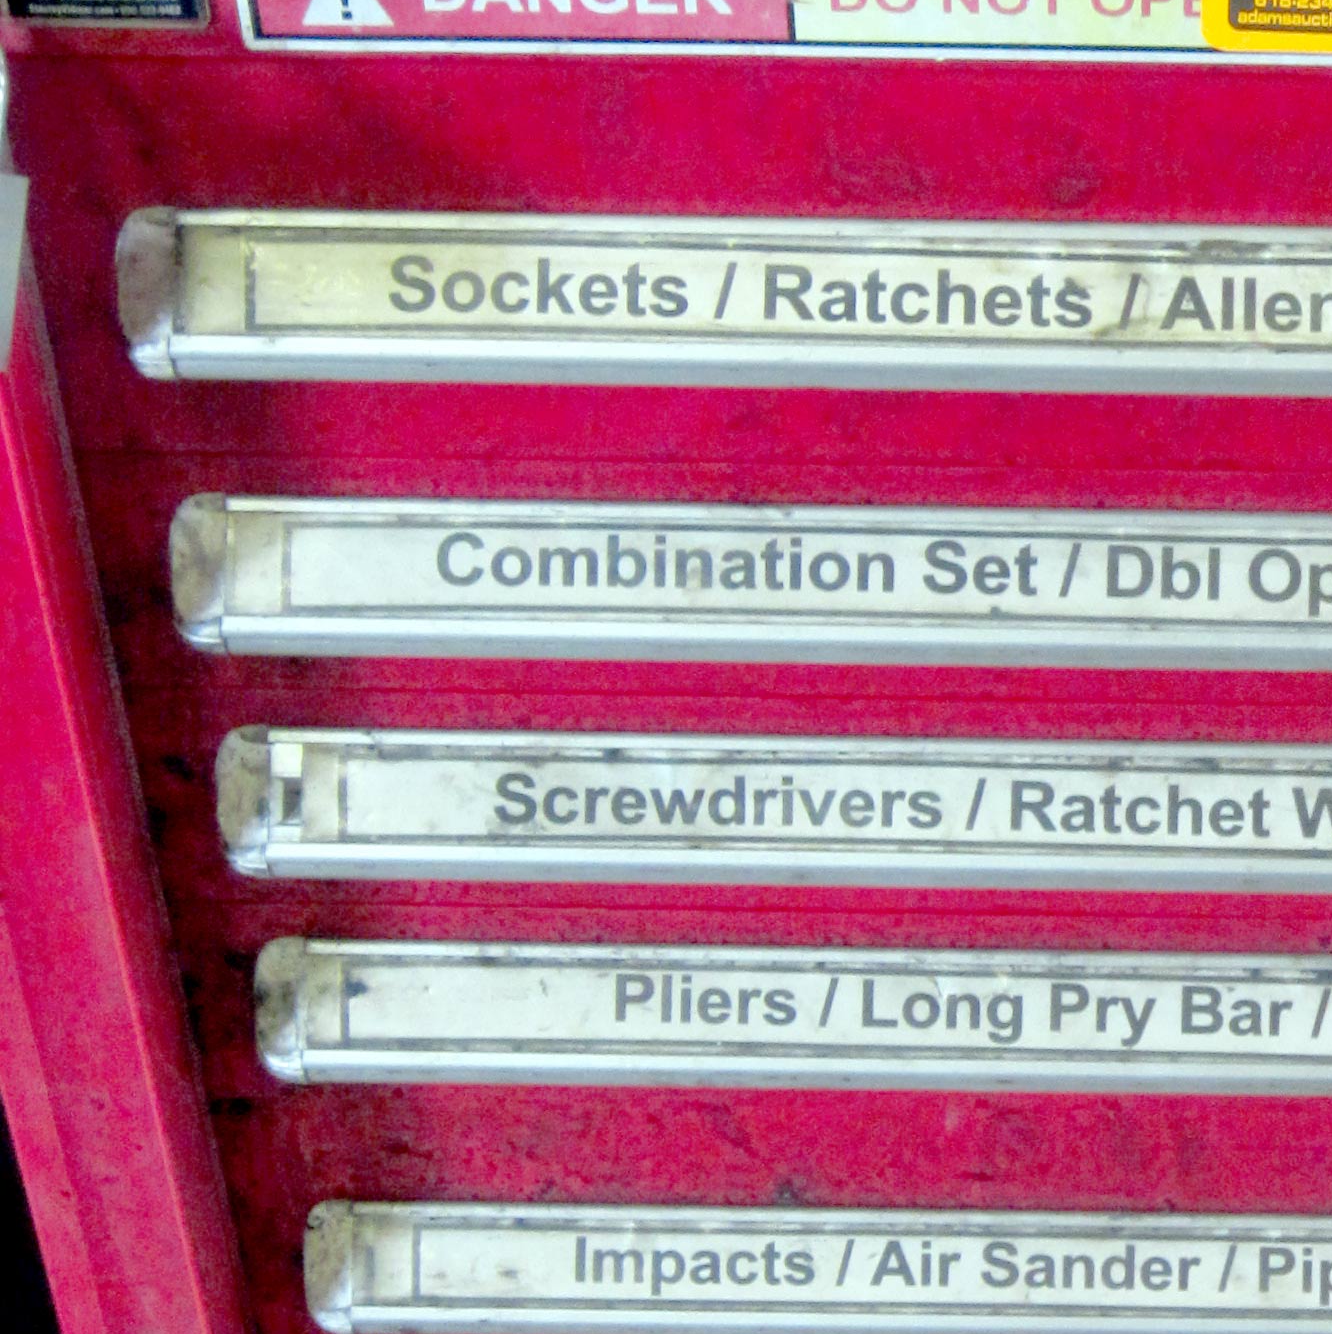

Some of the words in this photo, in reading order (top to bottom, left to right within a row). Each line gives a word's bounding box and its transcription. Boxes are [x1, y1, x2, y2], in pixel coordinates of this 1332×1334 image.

[389, 253, 689, 319] Sockets
[763, 263, 1092, 330] Ratchets
[436, 533, 897, 595] Combination
[922, 539, 1037, 597] Set
[1105, 542, 1221, 602] Dbl
[494, 773, 943, 830] Screwdrivers
[1010, 780, 1271, 836] Ratchet
[613, 974, 797, 1026] Pliers
[860, 979, 1025, 1043] Long
[1047, 982, 1156, 1050] Pry
[1180, 986, 1293, 1036] Bar
[574, 1236, 816, 1296] Impacts
[870, 1241, 960, 1288] Air
[981, 1241, 1200, 1292] Sander
